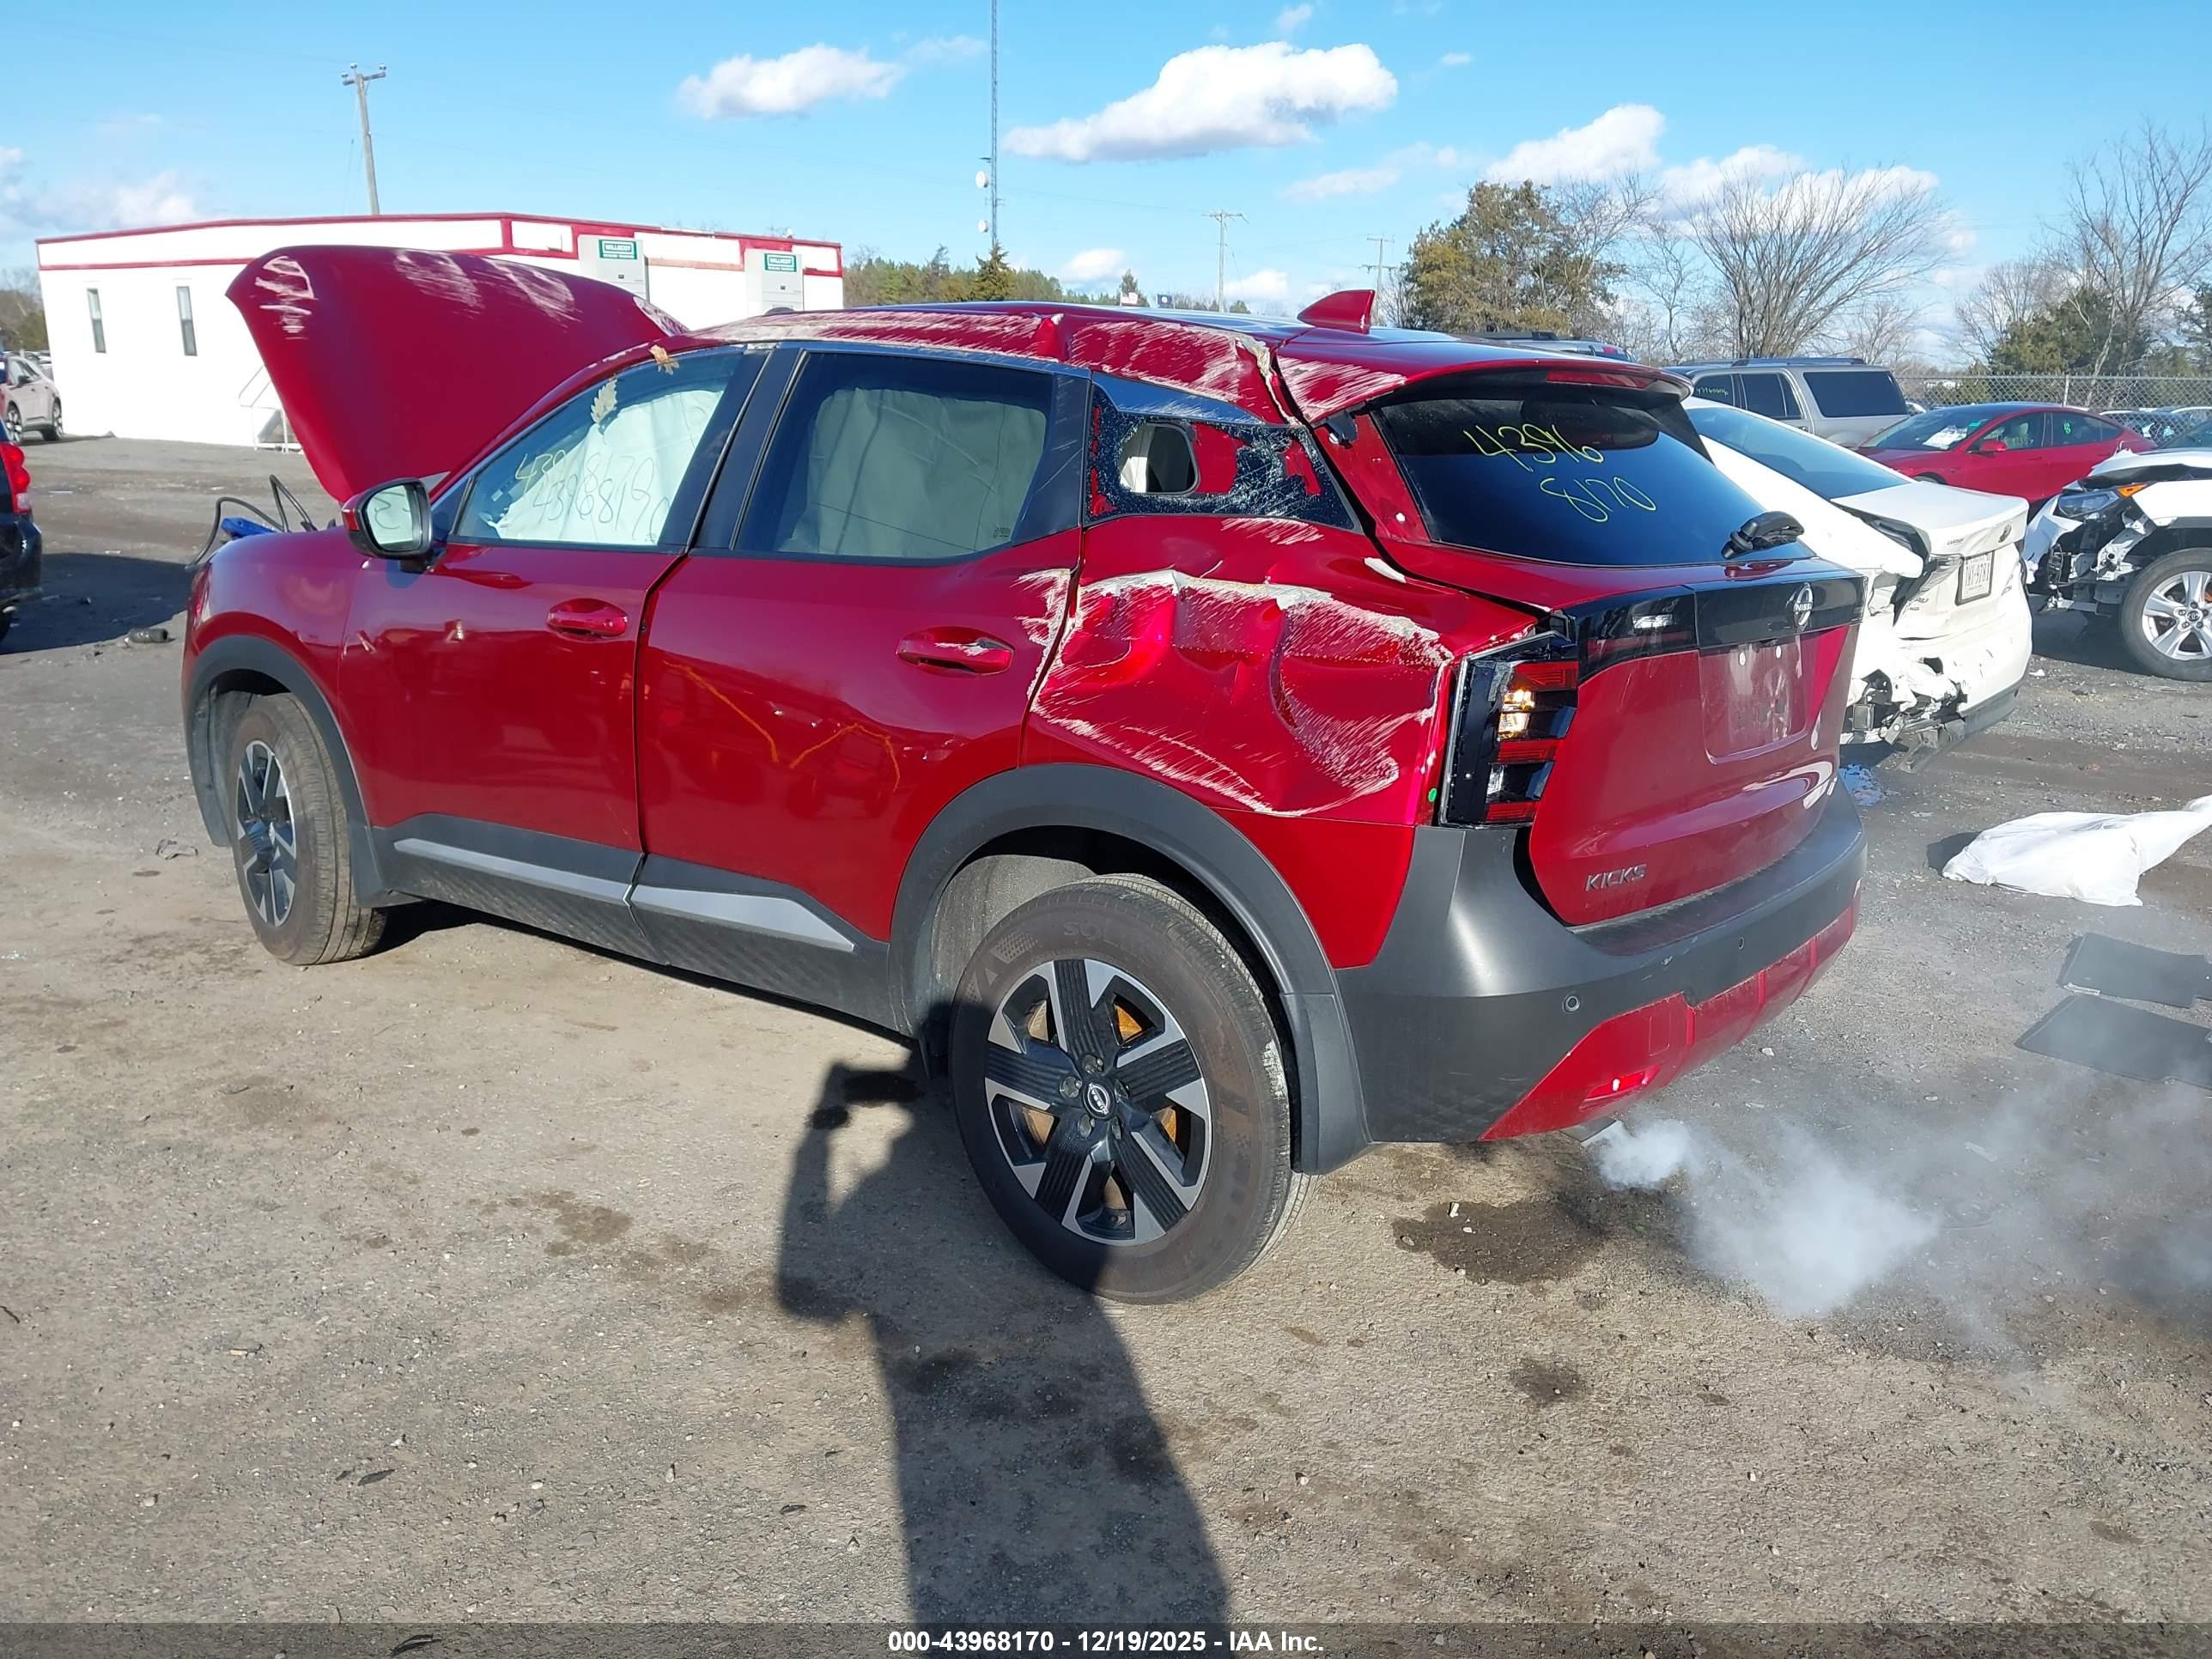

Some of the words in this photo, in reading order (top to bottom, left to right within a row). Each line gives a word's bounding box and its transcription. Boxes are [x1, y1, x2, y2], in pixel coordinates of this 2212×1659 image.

[1462, 423, 1604, 472] 4396
[1540, 476, 1657, 523] 8170
[1795, 603, 1813, 611] NISS
[1584, 864, 1647, 891] KICKS
